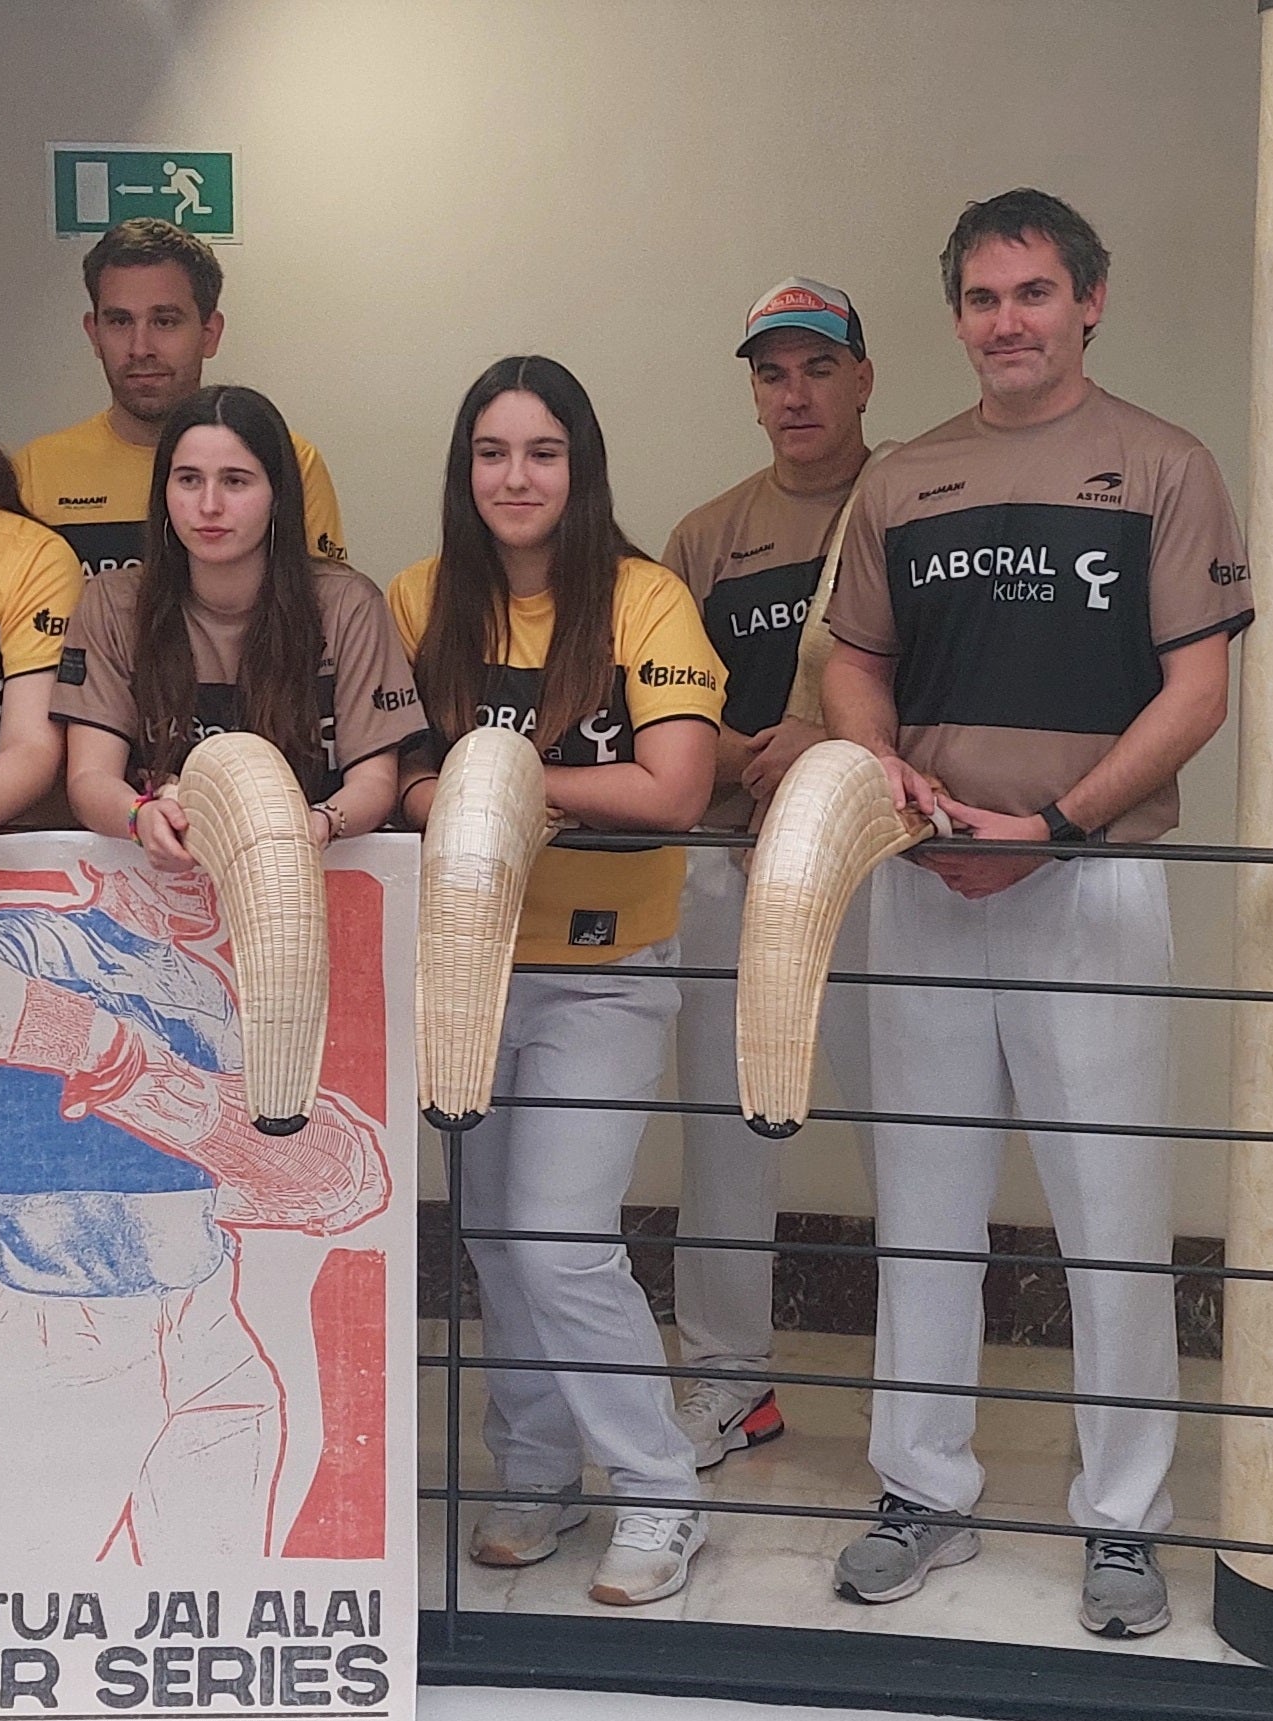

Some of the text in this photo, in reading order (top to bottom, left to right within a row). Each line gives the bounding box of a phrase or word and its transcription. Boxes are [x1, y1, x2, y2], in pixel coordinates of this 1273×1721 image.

[910, 546, 1056, 588] LABORAL
[993, 579, 1055, 602] kutxa
[135, 1591, 220, 1640] JAI
[245, 1589, 382, 1639] ALAI
[94, 1644, 390, 1709] SERIES
